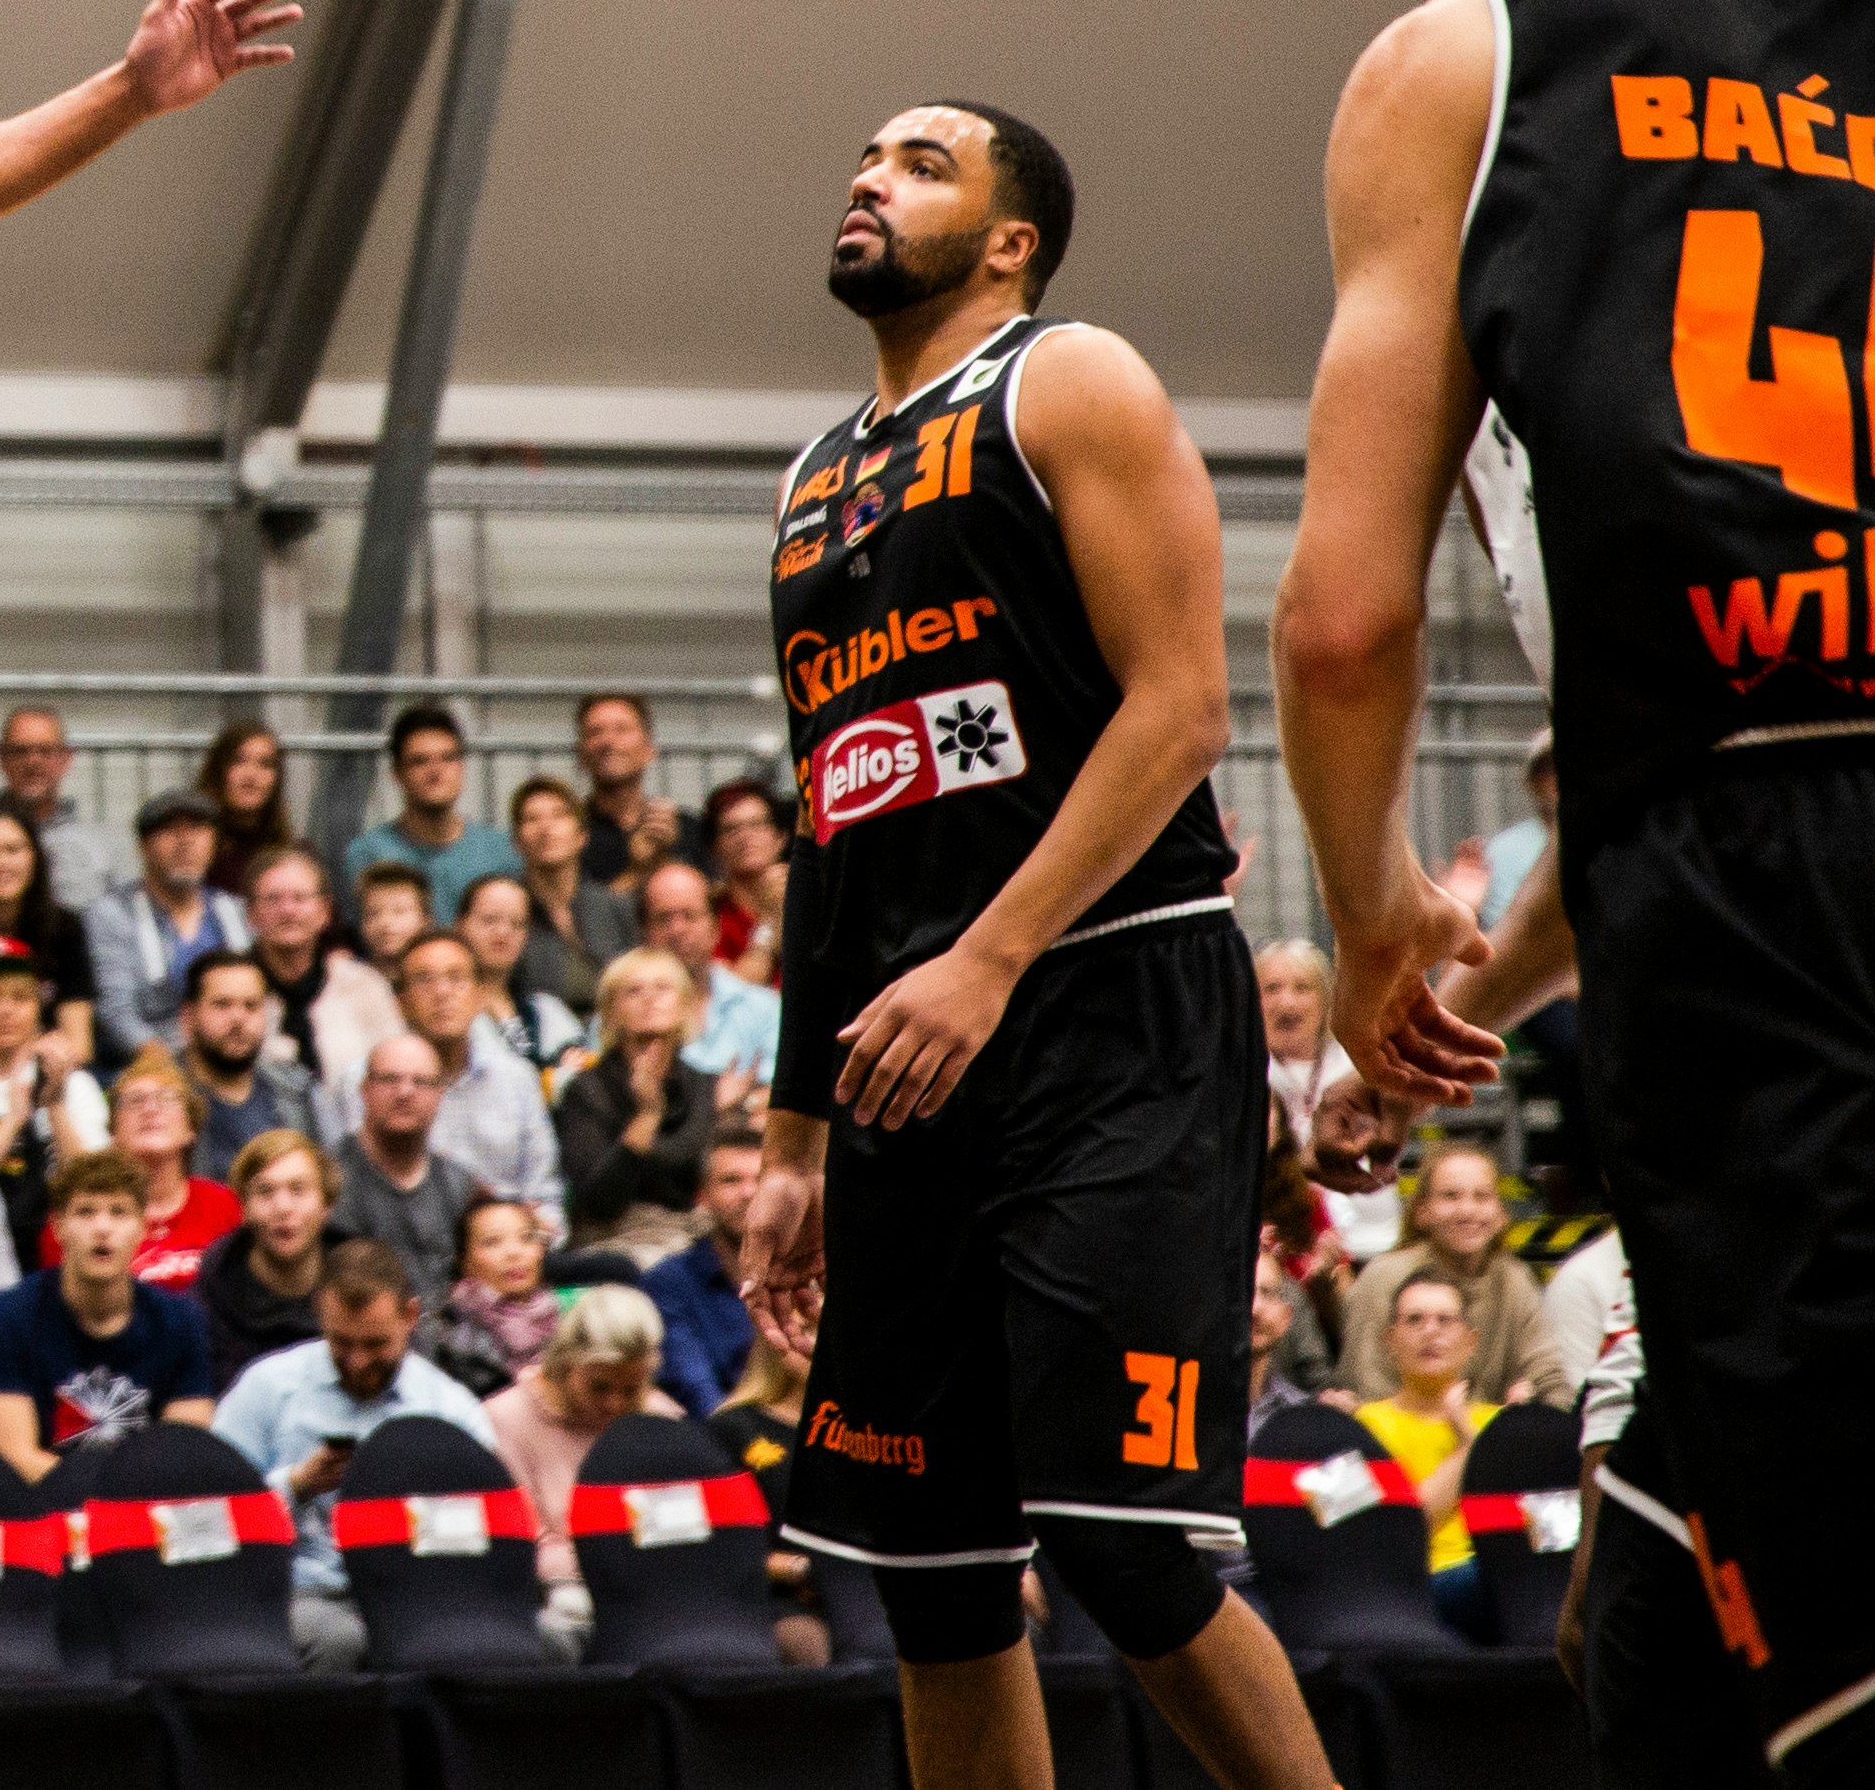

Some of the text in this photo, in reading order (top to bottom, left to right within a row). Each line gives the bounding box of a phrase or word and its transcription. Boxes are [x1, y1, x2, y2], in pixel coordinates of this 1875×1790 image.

[1671, 209, 1875, 511] 4
[903, 403, 983, 513] 31
[796, 597, 997, 713] Kübler
[1687, 526, 1875, 670] wi
[822, 739, 921, 814] Helios
[1123, 1350, 1200, 1471] 31
